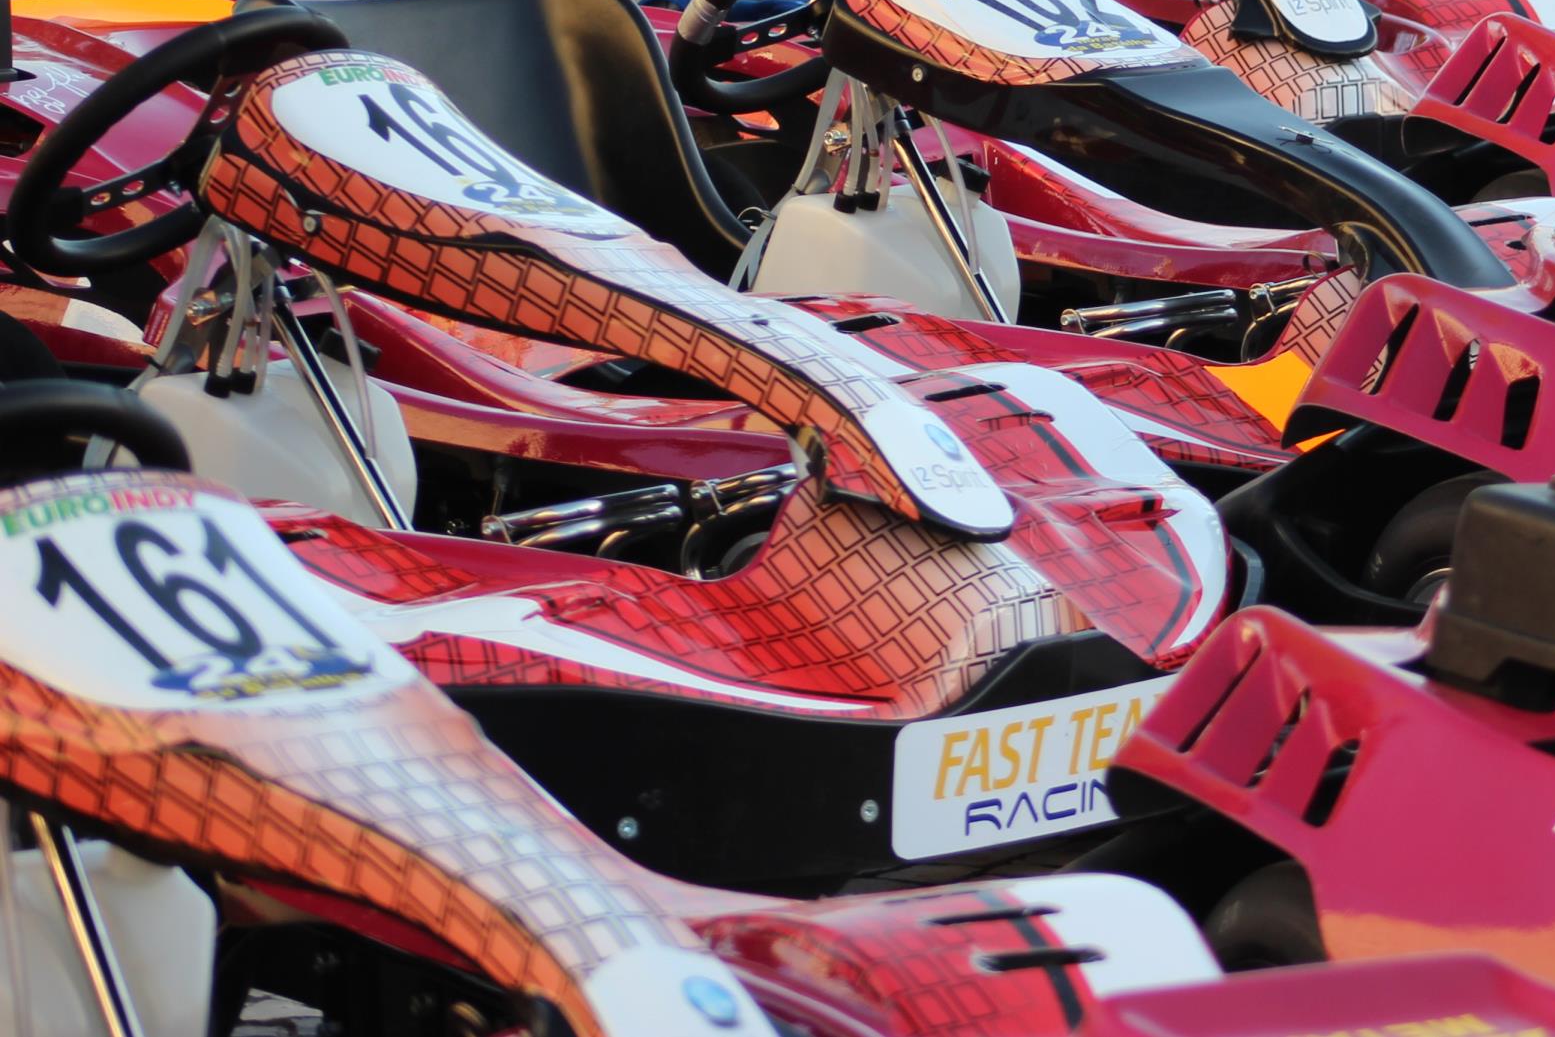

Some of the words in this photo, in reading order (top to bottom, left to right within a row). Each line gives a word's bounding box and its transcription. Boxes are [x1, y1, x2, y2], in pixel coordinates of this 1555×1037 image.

[1045, 20, 1122, 44] 24
[475, 182, 558, 206] 24
[2, 487, 196, 537] EUROINDY
[35, 518, 340, 671] 161
[933, 715, 1055, 800] FAST
[1068, 694, 1160, 776] TEA
